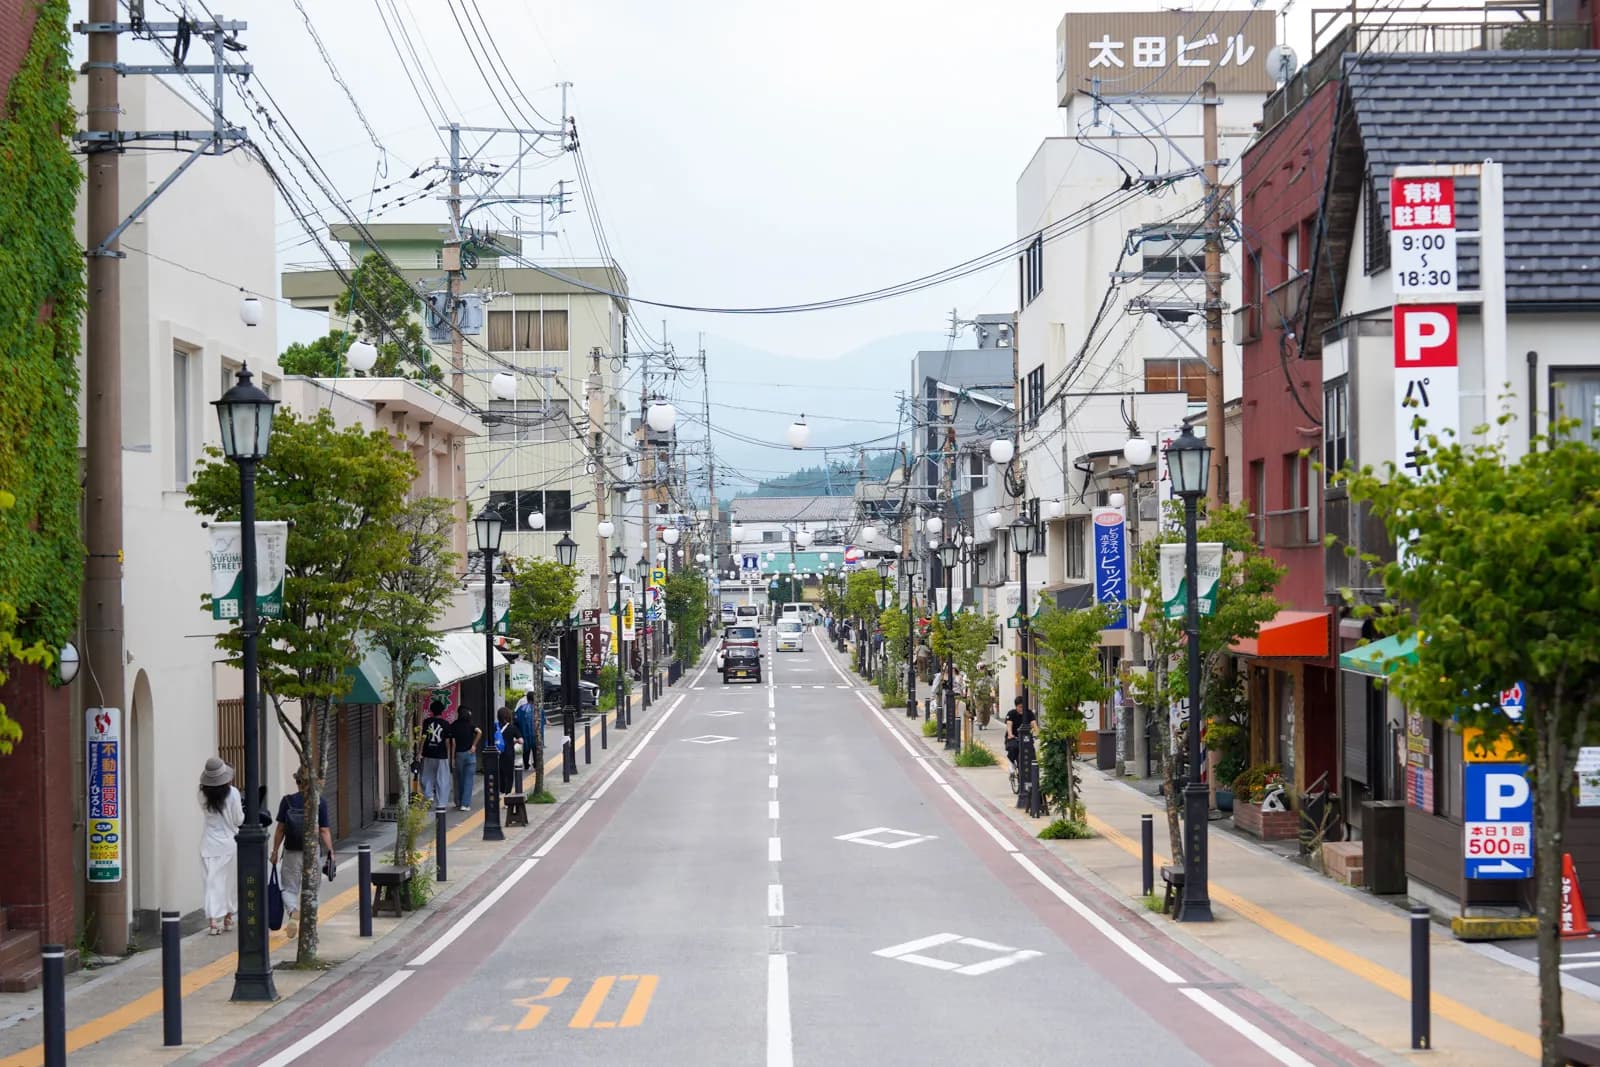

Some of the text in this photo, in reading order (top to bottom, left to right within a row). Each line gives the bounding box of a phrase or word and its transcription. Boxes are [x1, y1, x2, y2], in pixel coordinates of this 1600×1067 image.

[1088, 34, 1256, 69] 太田ビル
[1403, 182, 1442, 203] 有料
[1394, 205, 1452, 226] 駐車場
[1402, 234, 1446, 251] 9:00
[1398, 270, 1452, 287] 18:30
[1404, 311, 1450, 361] P
[1100, 534, 1111, 554] ホテル
[1108, 527, 1120, 554] ビジネス
[212, 562, 242, 570] STREET
[653, 571, 664, 582] P
[101, 743, 117, 817] 不動産買取
[1485, 773, 1530, 820] P
[1471, 826, 1525, 836] 本日1回
[1469, 838, 1526, 855] 500円
[464, 974, 660, 1032] 30
